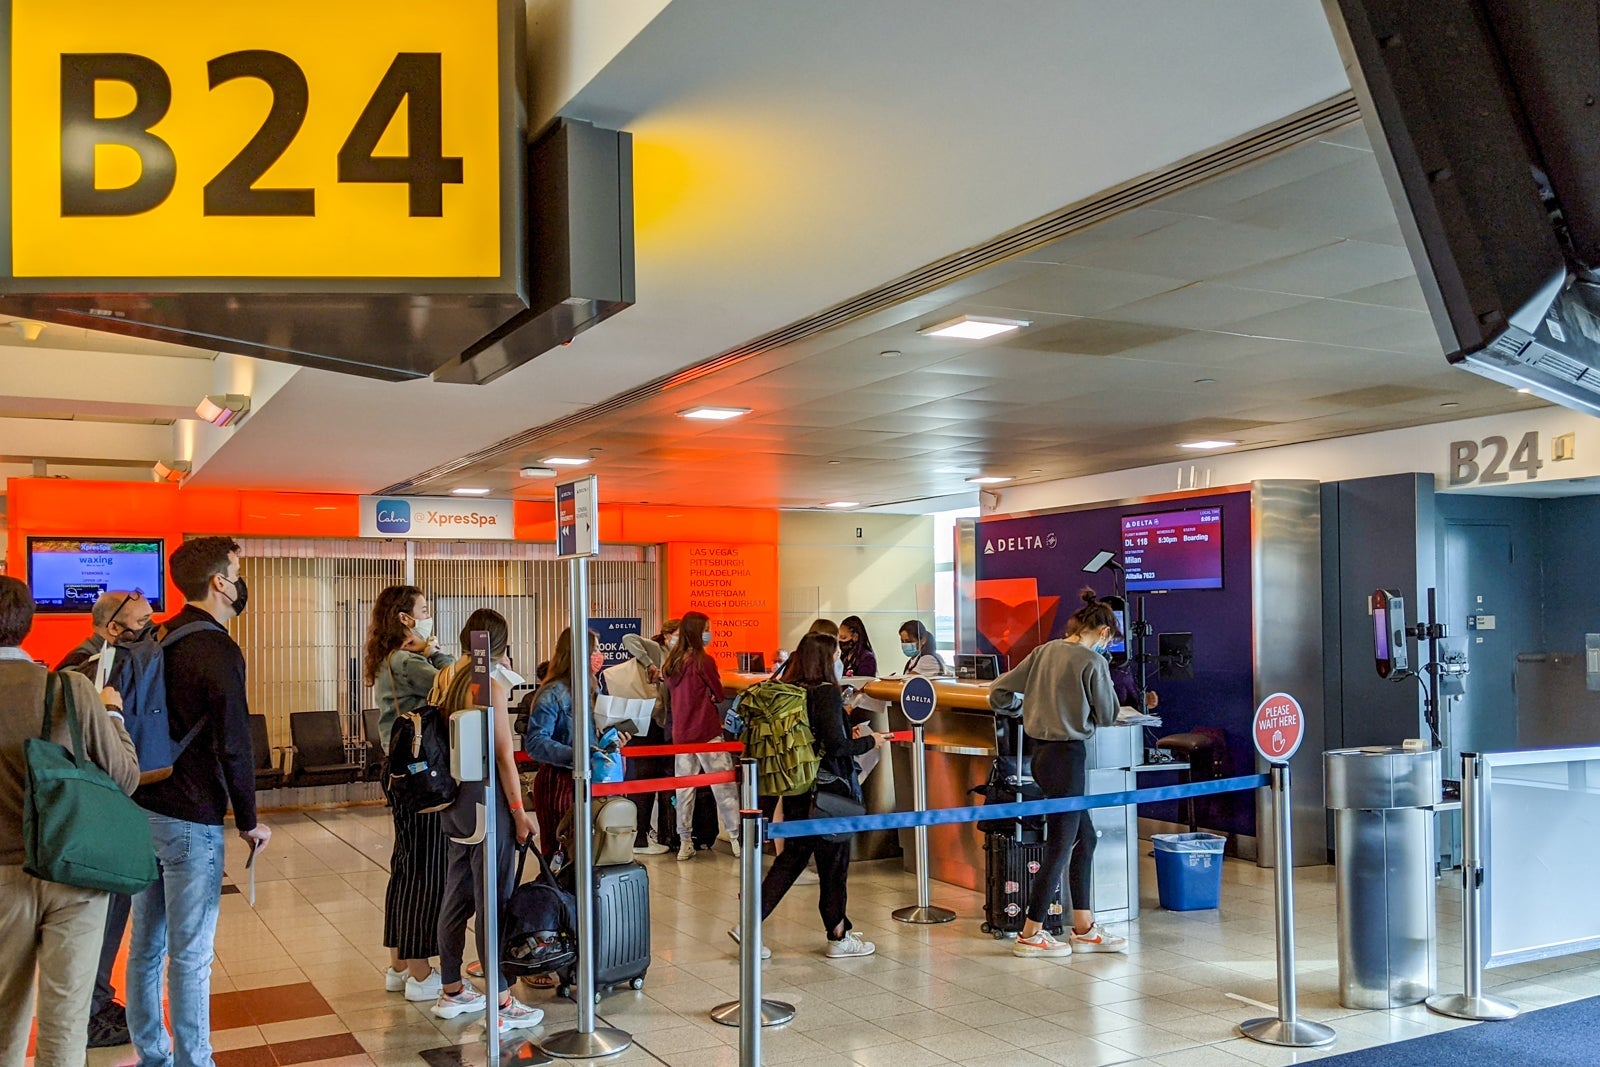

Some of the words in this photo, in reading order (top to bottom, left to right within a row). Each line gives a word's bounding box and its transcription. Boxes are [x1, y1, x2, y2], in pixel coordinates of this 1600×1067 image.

[60, 49, 464, 218] B24
[1450, 431, 1543, 486] B24
[377, 510, 409, 523] Calm
[427, 511, 497, 527] XpresSpa
[1183, 534, 1209, 542] Boarding
[998, 535, 1043, 552] DELTA
[1125, 539, 1134, 547] DL
[690, 548, 707, 556] LAS
[709, 548, 739, 556] VEGAS
[79, 555, 113, 565] waxing
[690, 558, 745, 567] PITTSBURGH
[1124, 556, 1142, 564] Milan
[690, 569, 752, 577] PHILADELPHIA
[690, 579, 732, 587] HOUSTON
[598, 643, 617, 651] OOK
[615, 652, 631, 660] ON.
[911, 695, 931, 704] DELTA
[1266, 705, 1290, 717] PLEASE
[1259, 718, 1278, 730] WAIT
[1279, 715, 1297, 727] HERE
